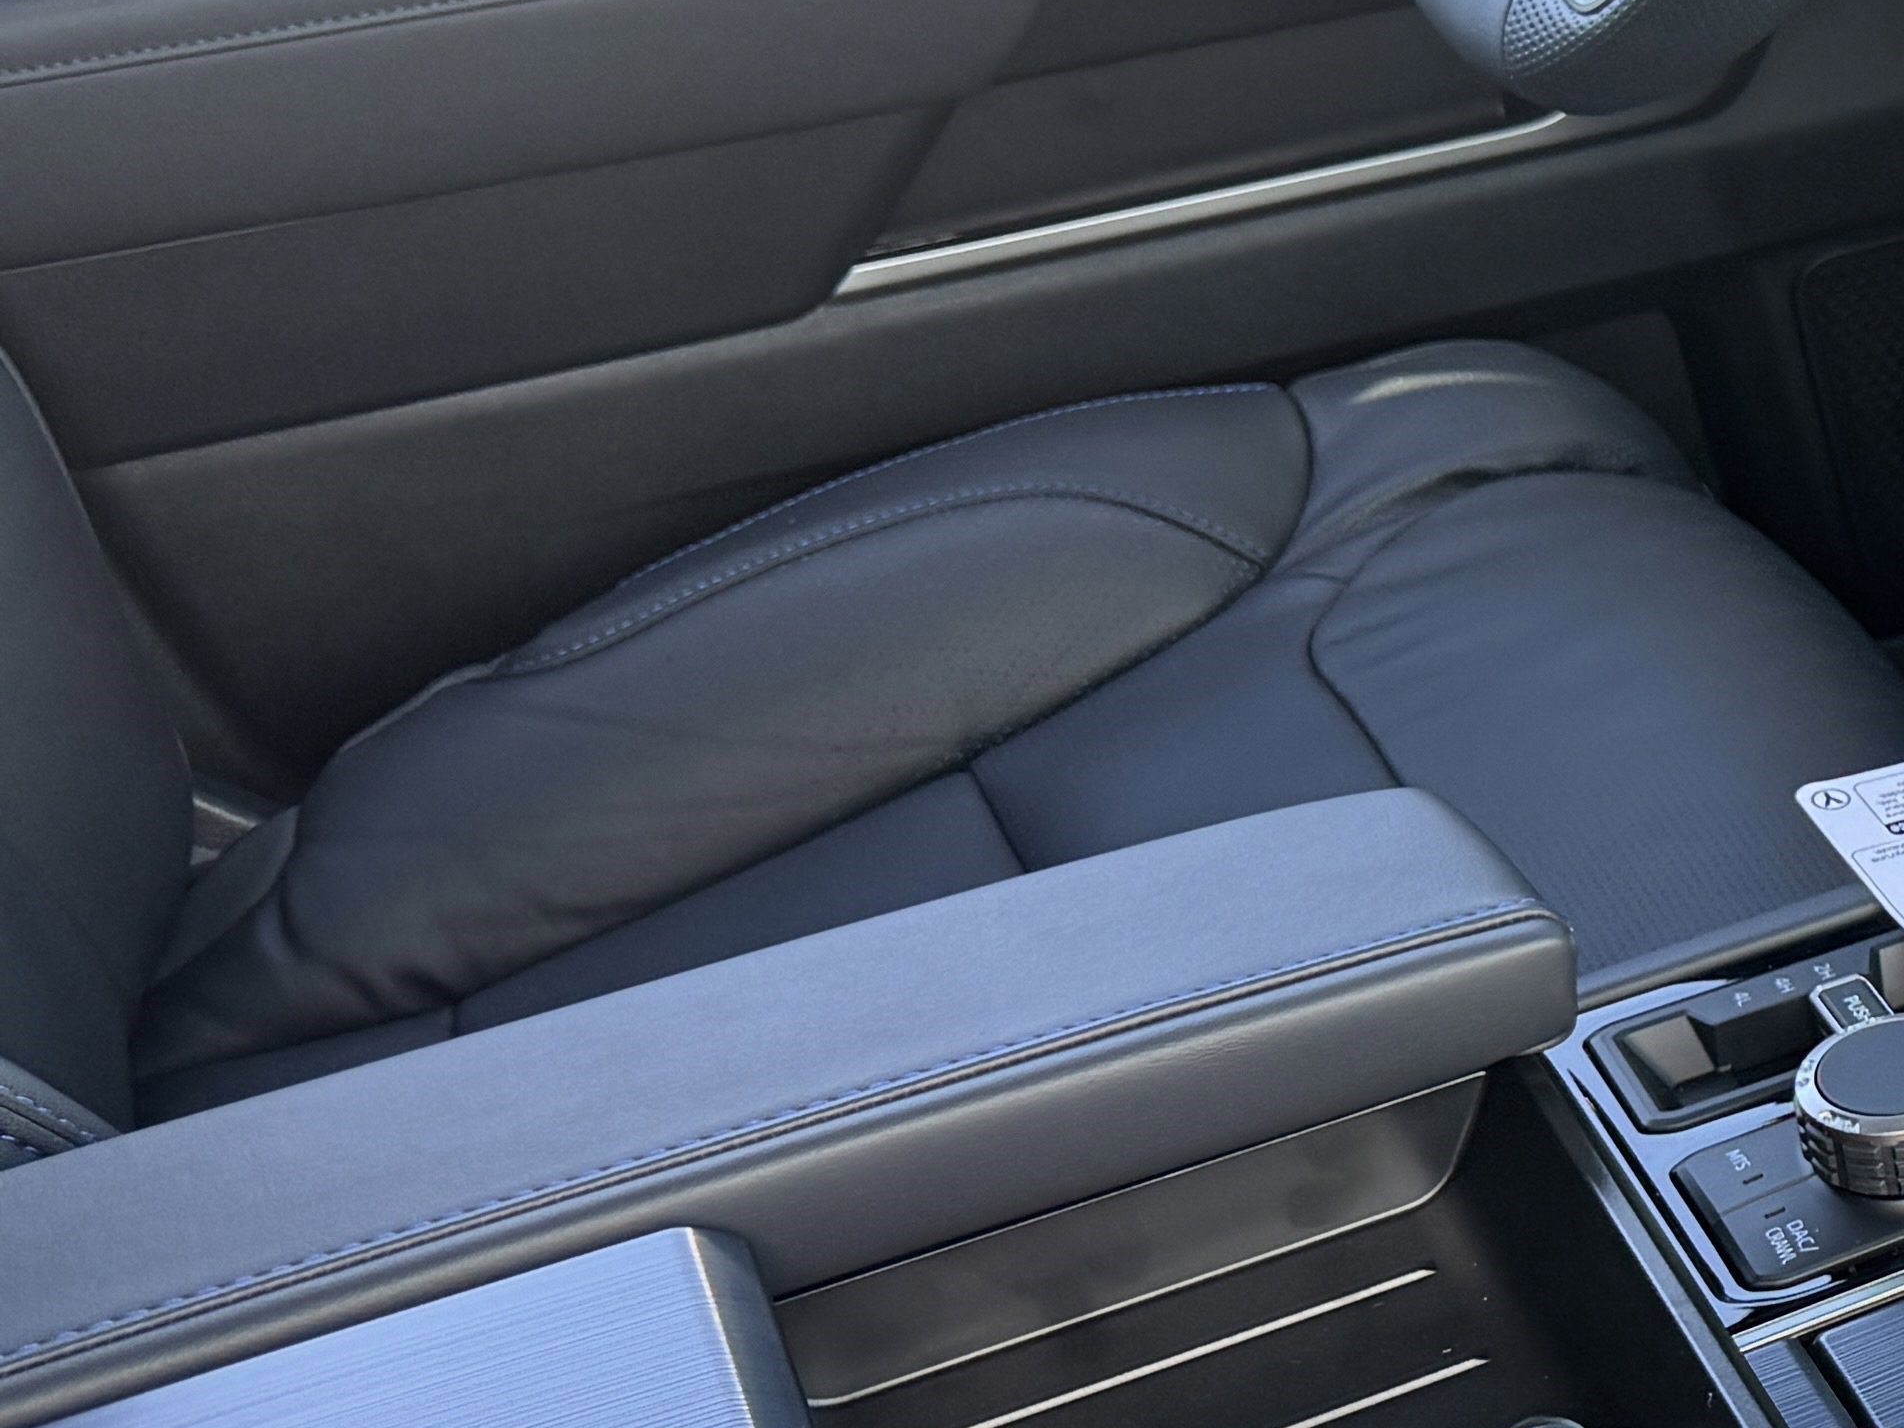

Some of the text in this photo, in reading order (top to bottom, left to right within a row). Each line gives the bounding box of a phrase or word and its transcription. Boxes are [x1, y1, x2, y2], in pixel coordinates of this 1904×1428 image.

[1813, 962, 1836, 981] 2H
[1774, 977, 1796, 994] 4H
[1734, 991, 1751, 1008] 4L
[1725, 1148, 1752, 1171] MTS
[1765, 1226, 1797, 1265] CRAWL
[1786, 1219, 1820, 1253] DAC/
